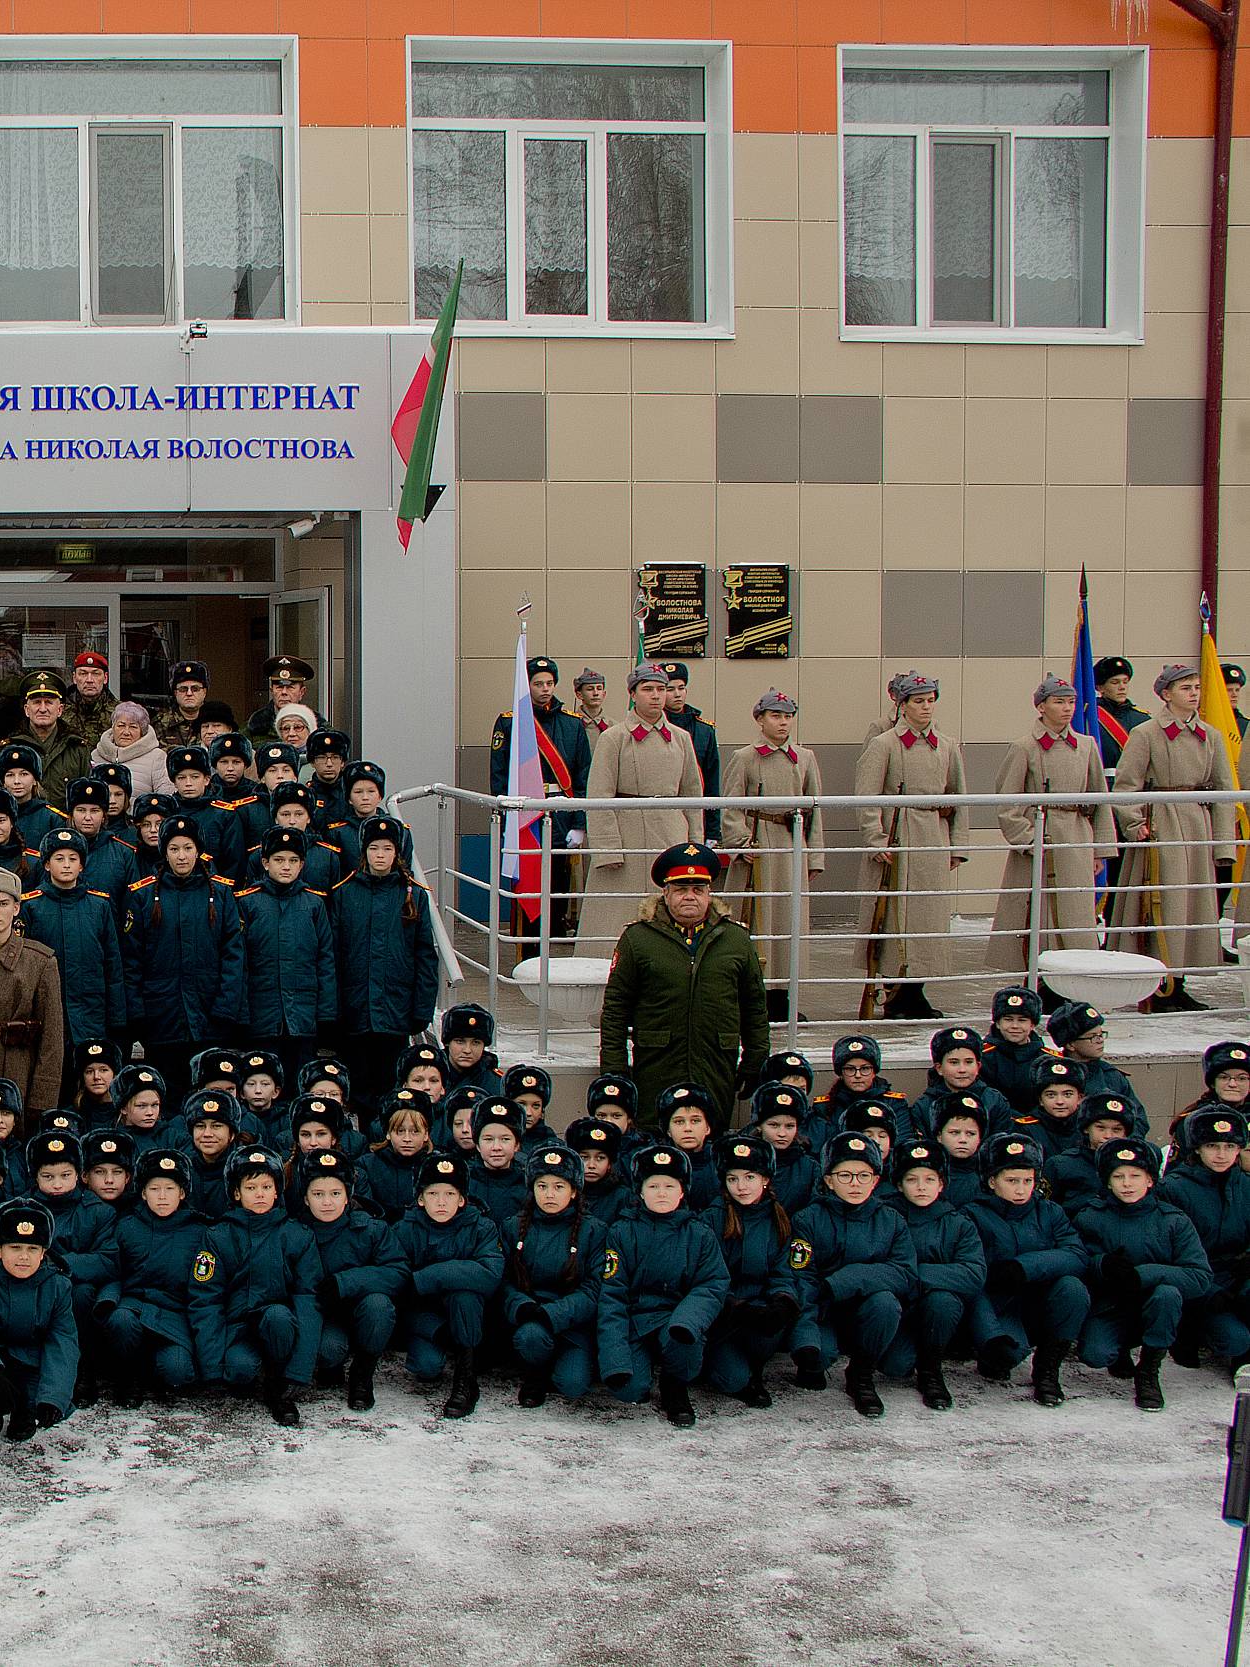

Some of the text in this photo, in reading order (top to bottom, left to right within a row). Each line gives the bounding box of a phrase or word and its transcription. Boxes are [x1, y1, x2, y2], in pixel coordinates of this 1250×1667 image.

[30, 383, 361, 412] ШКОЛА-ИНТЕРНАТ
[25, 438, 160, 460] НИКОЛАЯ
[167, 438, 356, 460] ВОЛОСТНОВА
[743, 595, 786, 603] ВОЛОСТНОВ
